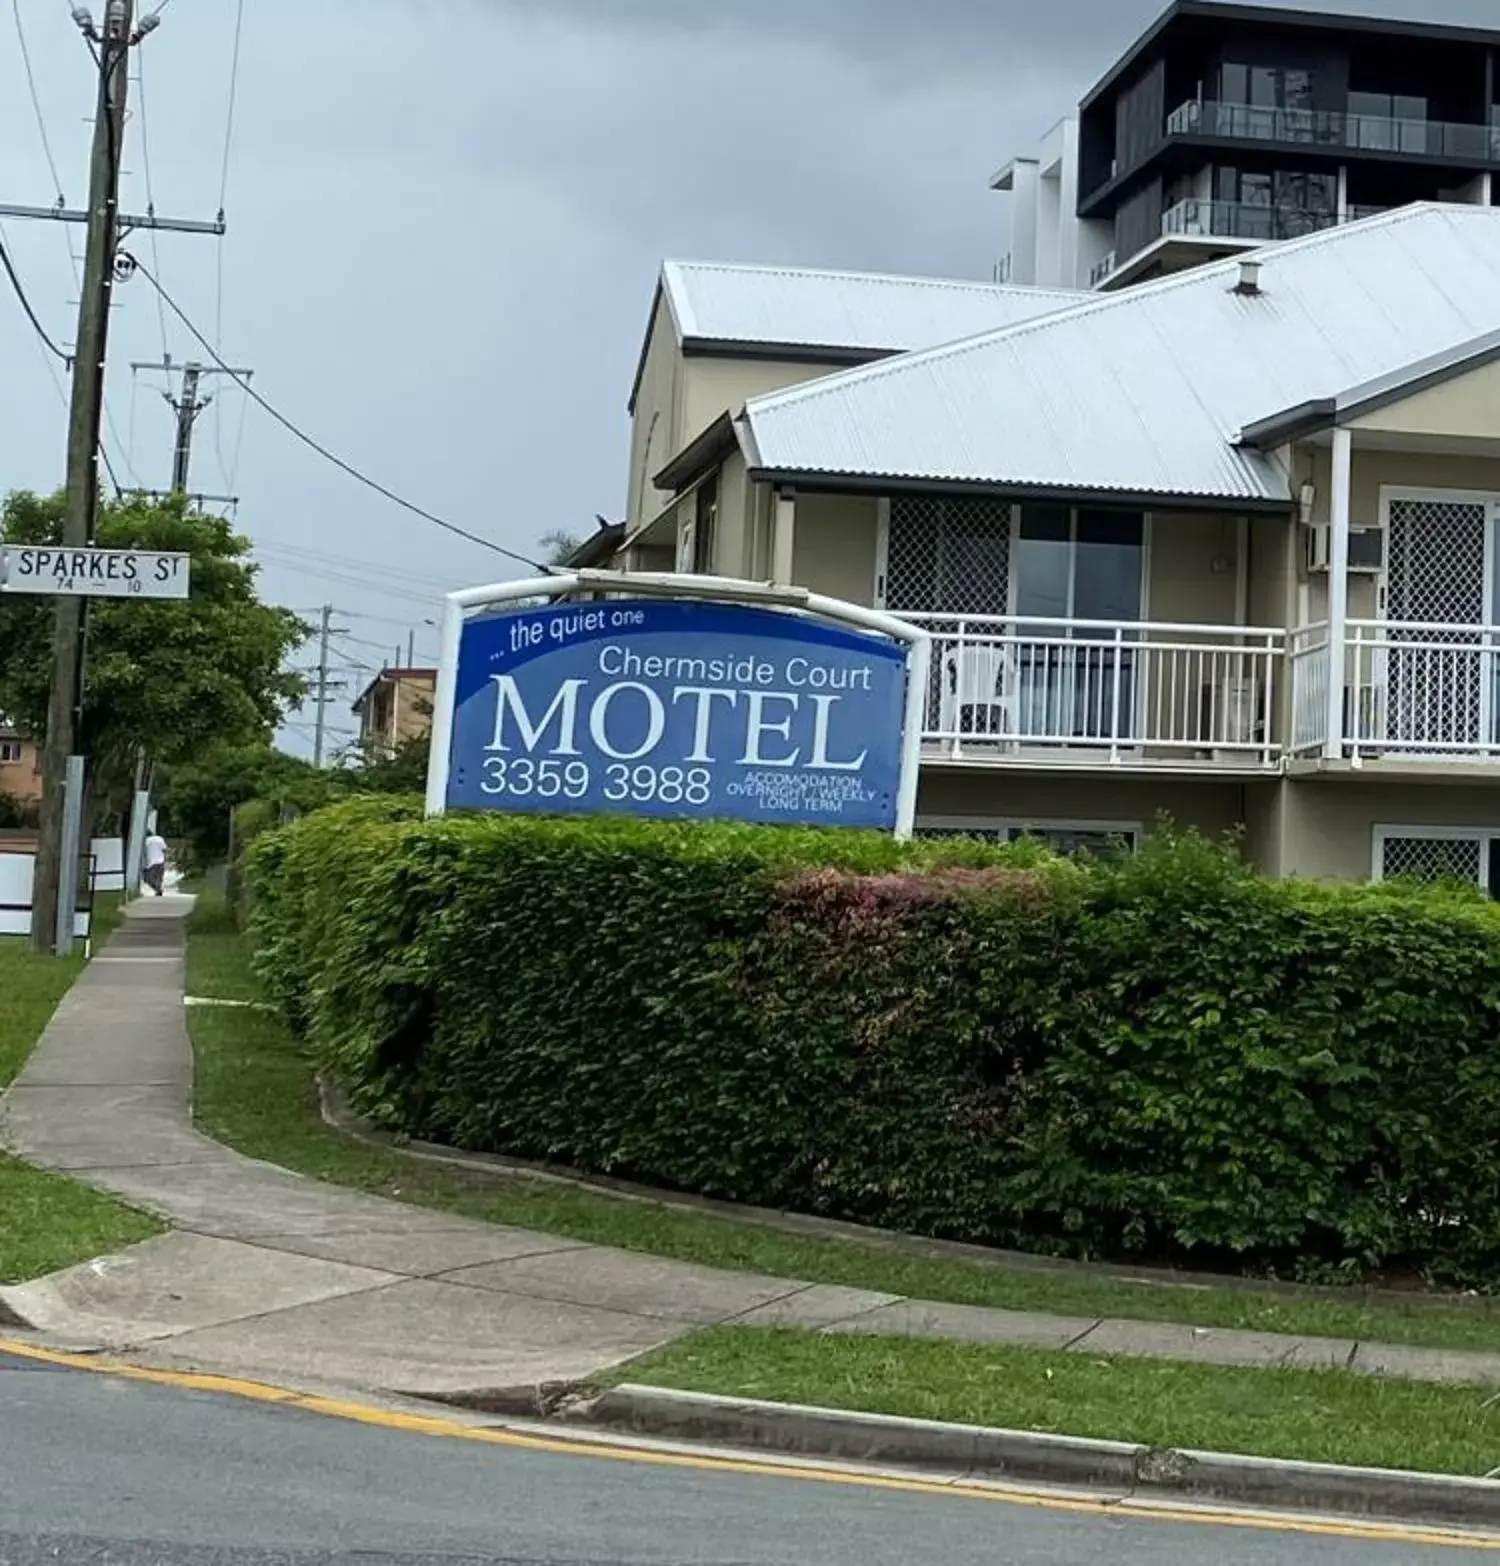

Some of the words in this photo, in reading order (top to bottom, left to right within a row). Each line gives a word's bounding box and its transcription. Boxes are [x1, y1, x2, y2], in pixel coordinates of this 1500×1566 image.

[18, 551, 137, 580] SPARKES
[154, 557, 180, 581] ST
[56, 577, 73, 590] 74
[127, 580, 141, 593] 10
[510, 619, 544, 651] the
[550, 608, 605, 642] quiet
[611, 610, 645, 627] one
[599, 645, 775, 685] Chermside
[786, 657, 872, 691] Court
[482, 674, 868, 771] MOTEL
[480, 758, 589, 797] 3359
[603, 764, 711, 804] 3988
[744, 771, 863, 789] ACCOMODATION
[819, 786, 876, 801] WEEKLY
[760, 797, 799, 810] LONG
[804, 798, 843, 813] TERM
